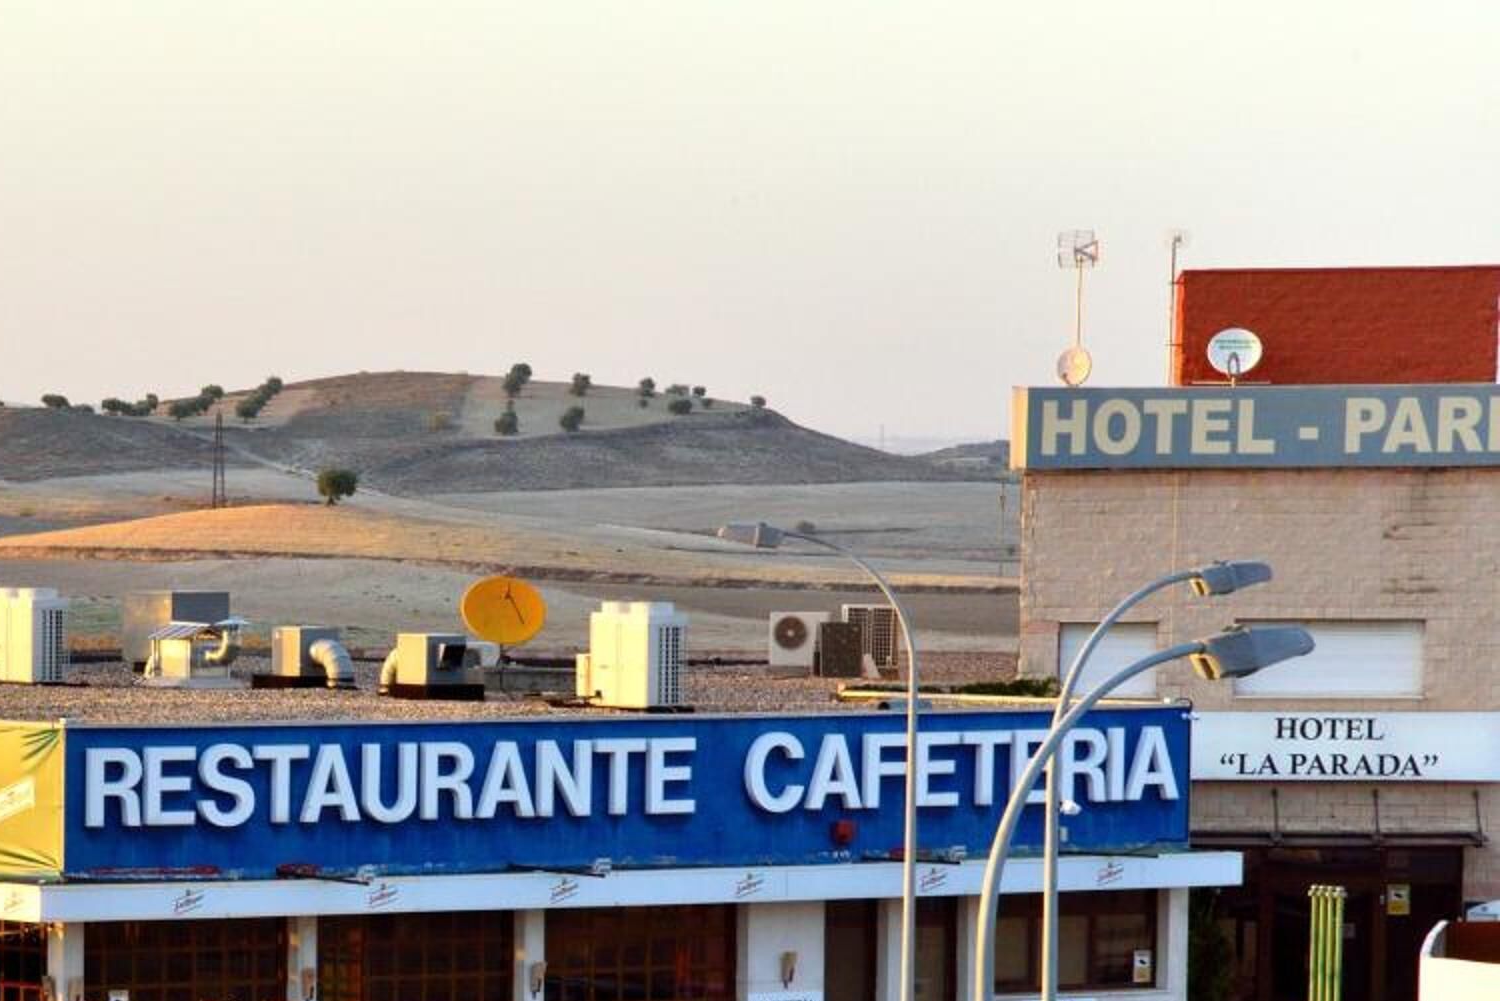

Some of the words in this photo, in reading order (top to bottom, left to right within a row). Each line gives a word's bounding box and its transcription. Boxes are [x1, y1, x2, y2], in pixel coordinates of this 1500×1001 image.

[1039, 397, 1275, 456] HOTEL
[1275, 716, 1385, 741] HOTEL
[83, 736, 697, 829] RESTAURANTE
[743, 725, 1181, 815] CAFETERIA
